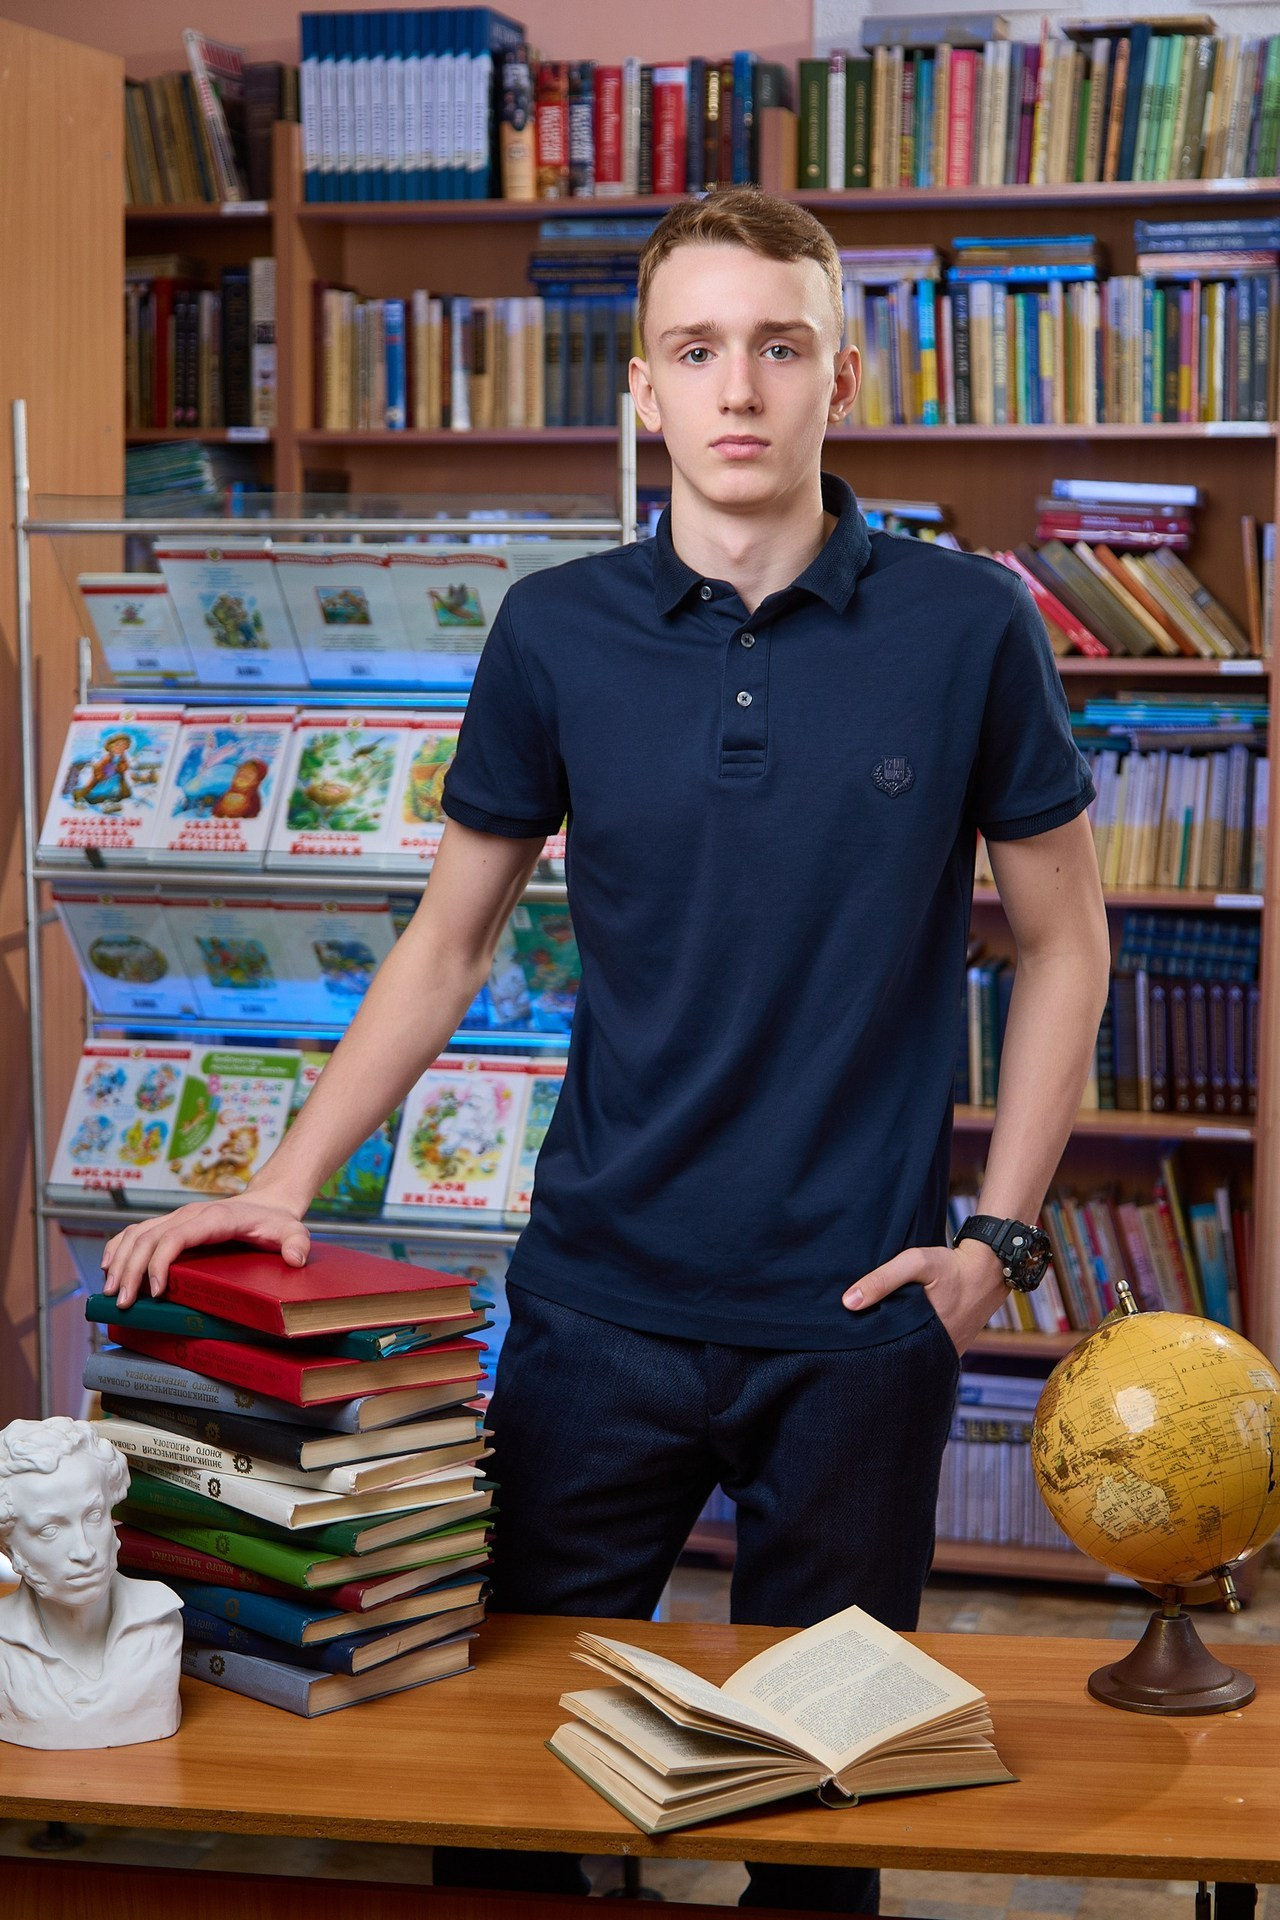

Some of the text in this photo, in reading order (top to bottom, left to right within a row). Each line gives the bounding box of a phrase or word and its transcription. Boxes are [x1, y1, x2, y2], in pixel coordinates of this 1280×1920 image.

[59, 816, 142, 828] РАССКАЗЫ
[184, 820, 240, 830] СКАЗКИ
[402, 1192, 488, 1207] ПИТОМЦЫ
[1181, 1359, 1223, 1373] OCEAN
[97, 1375, 220, 1404] ЭНЦИКЛОПЕДИЧЕСКИЙ СЛОВАРЬ
[125, 1370, 220, 1393] ЮНОГО ЛИТЕРАТУРОВЕДА
[109, 1439, 137, 1453] СЛОВА
[152, 1438, 222, 1459] ЮНОГО ФИЛОЛОГА
[141, 1445, 223, 1468] ЭНЦИКЛОПЕДИЧЕСКИЙ
[147, 1464, 201, 1492] ЭНЦИКЛОПЕДИЧЕСКИЙ
[1103, 1490, 1153, 1519] AUSTRALIA
[151, 1550, 202, 1569] МАТЕМАТИКА
[205, 1561, 234, 1575] ЮНОГО
[190, 1618, 218, 1632] ЮНОГО
